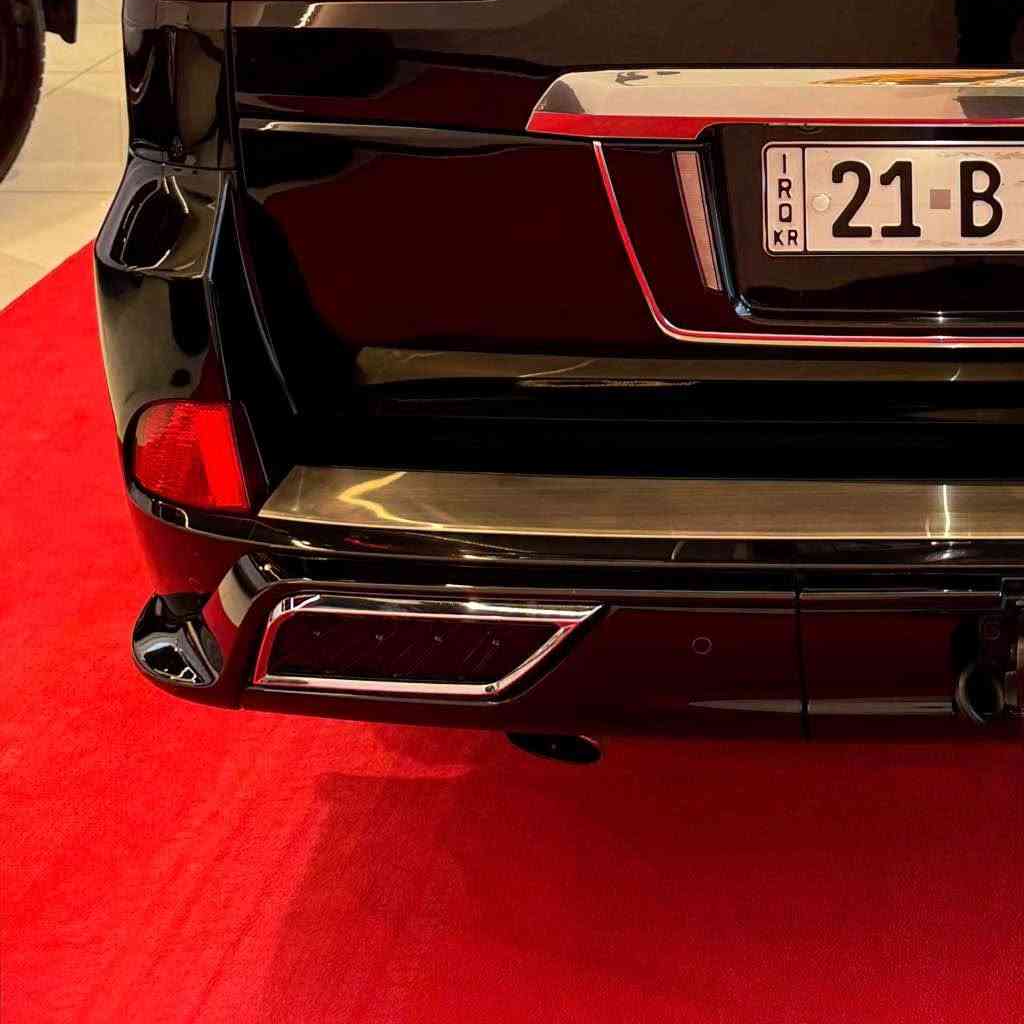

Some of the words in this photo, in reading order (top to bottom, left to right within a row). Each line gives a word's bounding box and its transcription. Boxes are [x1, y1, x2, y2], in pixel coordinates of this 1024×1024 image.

[831, 160, 922, 238] 21
[959, 160, 1002, 238] B
[773, 229, 799, 246] KR
